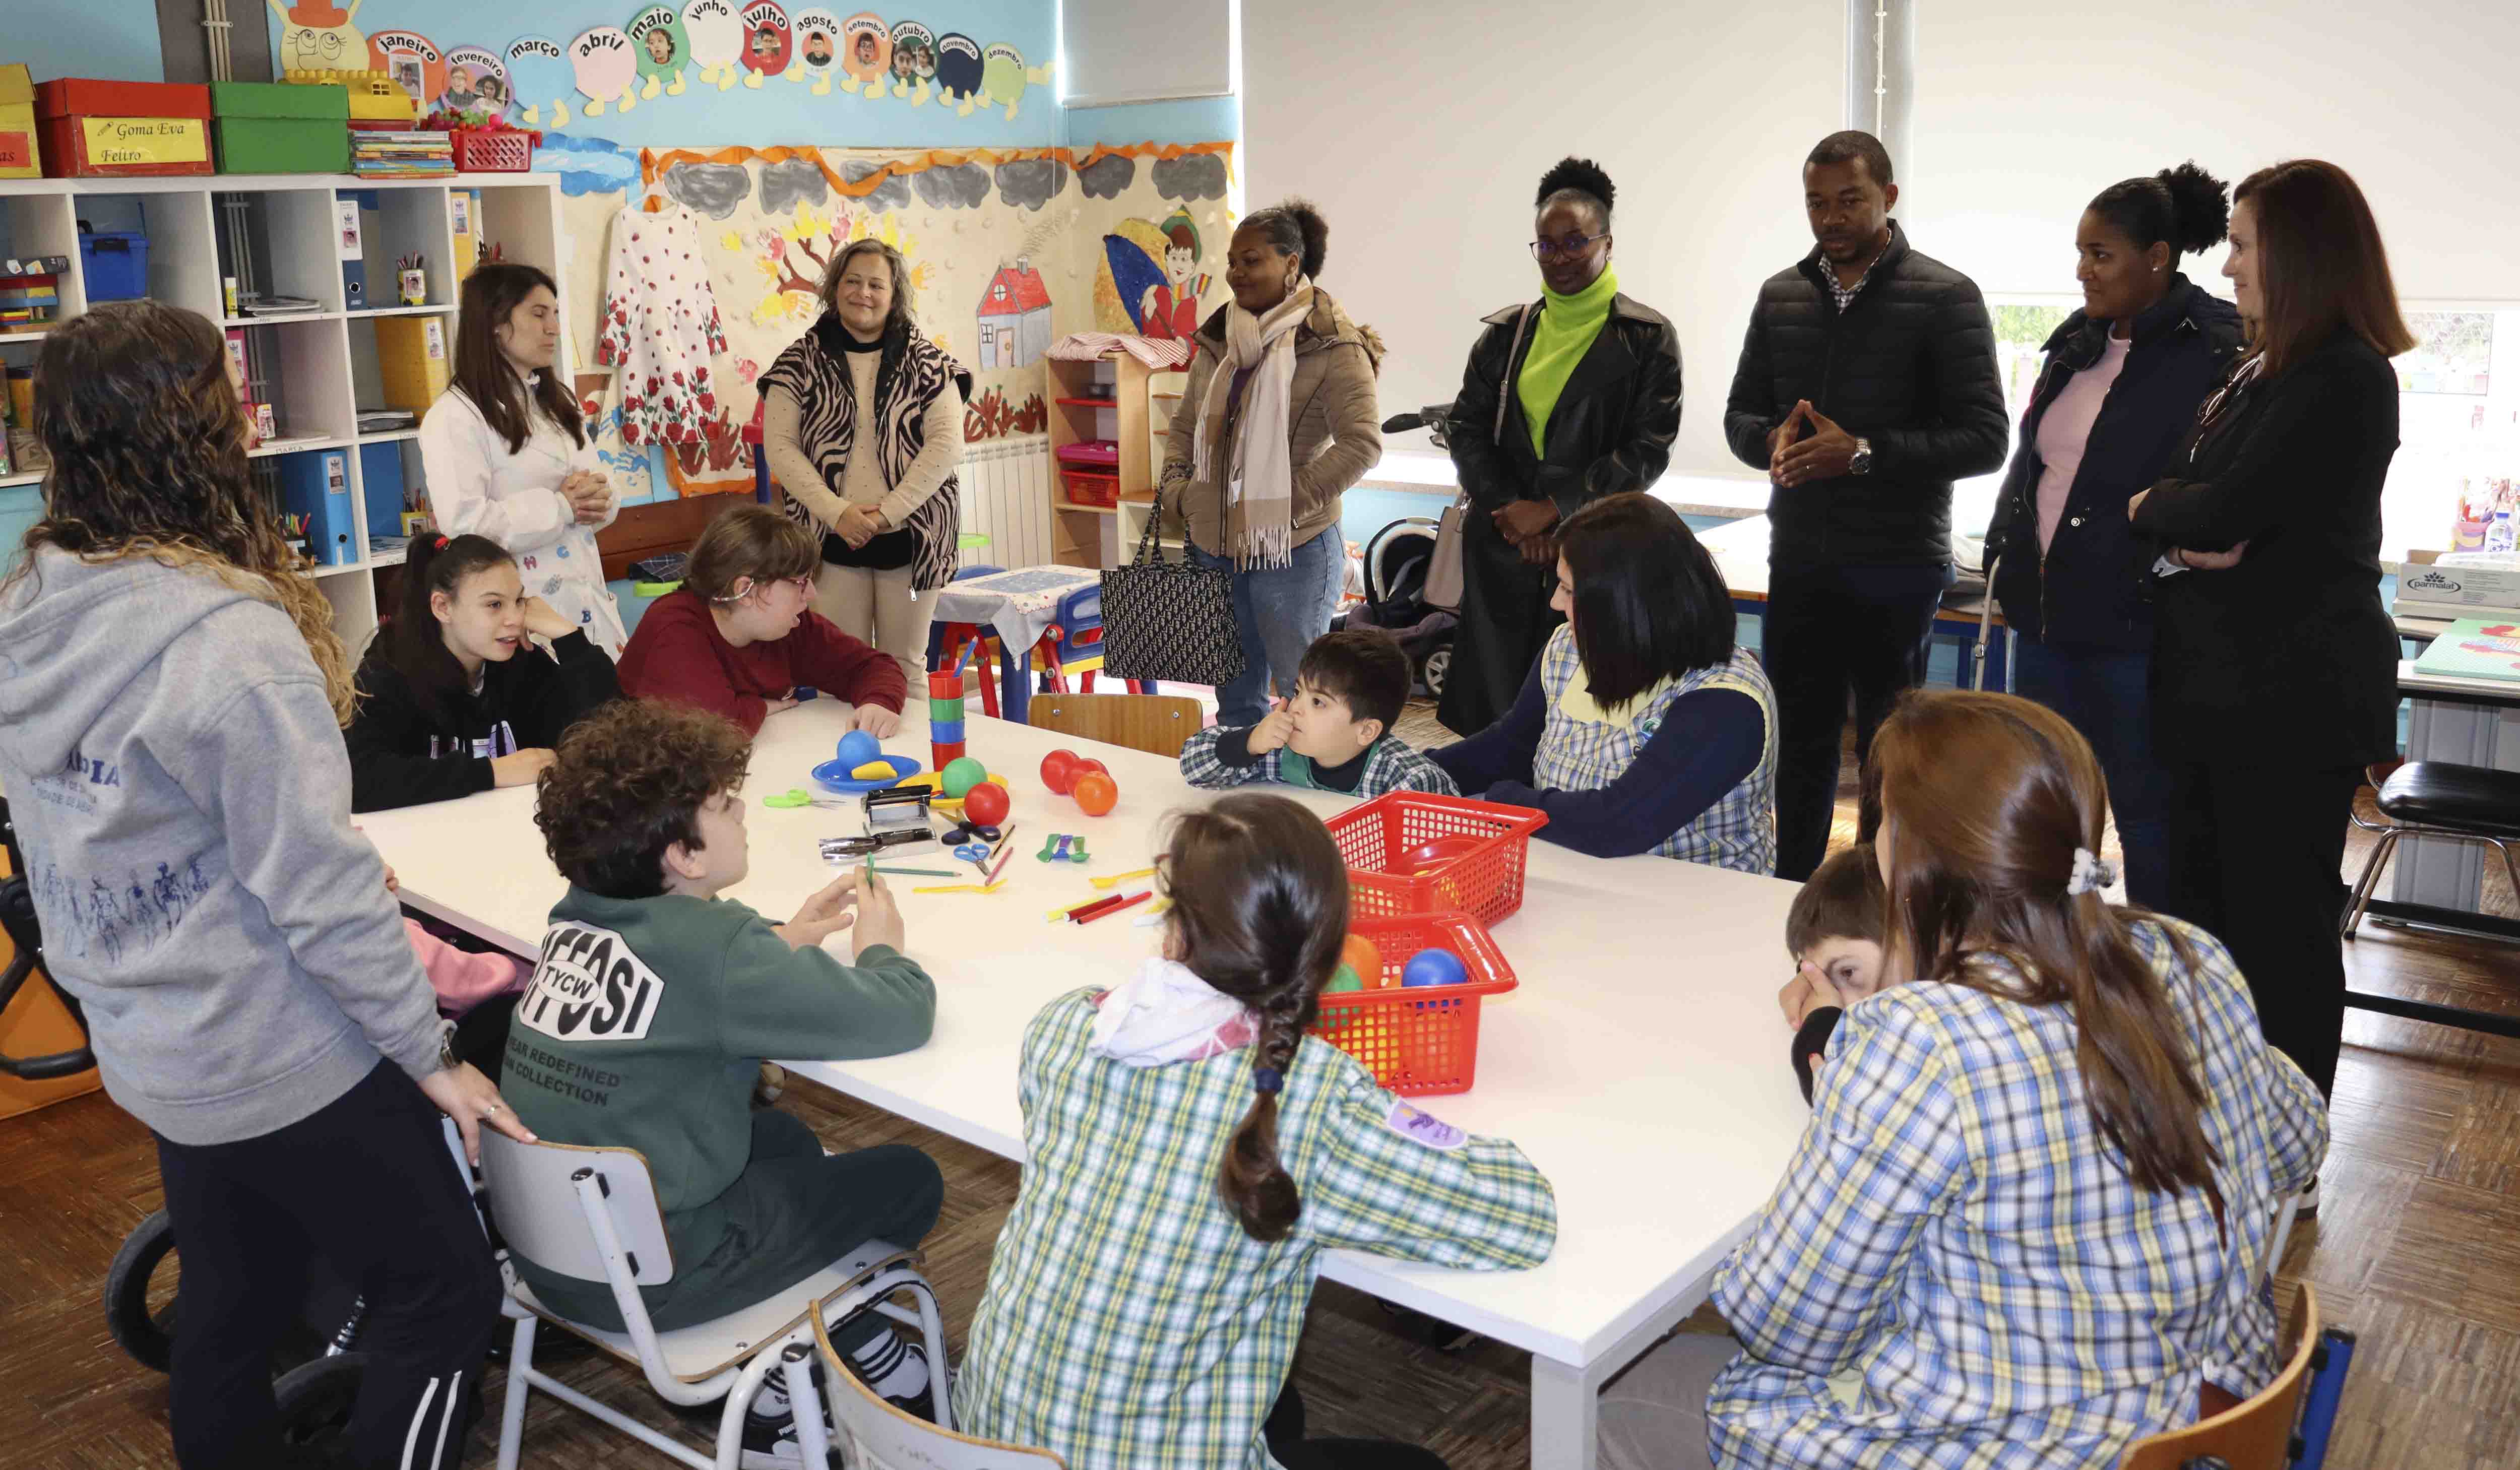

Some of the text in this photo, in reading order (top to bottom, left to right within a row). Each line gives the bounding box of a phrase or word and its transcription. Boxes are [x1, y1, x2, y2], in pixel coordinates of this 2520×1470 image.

[689, 0, 727, 21] junho
[744, 6, 786, 28] julho
[631, 8, 673, 41] maio
[797, 16, 837, 35] agosto
[848, 19, 886, 38] setembro
[893, 25, 929, 43] outubro
[378, 35, 436, 61] janeiro
[511, 40, 560, 59] março
[580, 33, 624, 57] abril
[941, 39, 976, 57] novembro
[451, 52, 502, 77] fevereiro
[988, 48, 1022, 71] dezembro
[117, 122, 185, 140] Goma Eva
[101, 147, 141, 162] Feltro
[543, 966, 595, 999] TYCW
[529, 1048, 621, 1087] REDEFINED
[515, 1061, 609, 1107] COLLECTION
